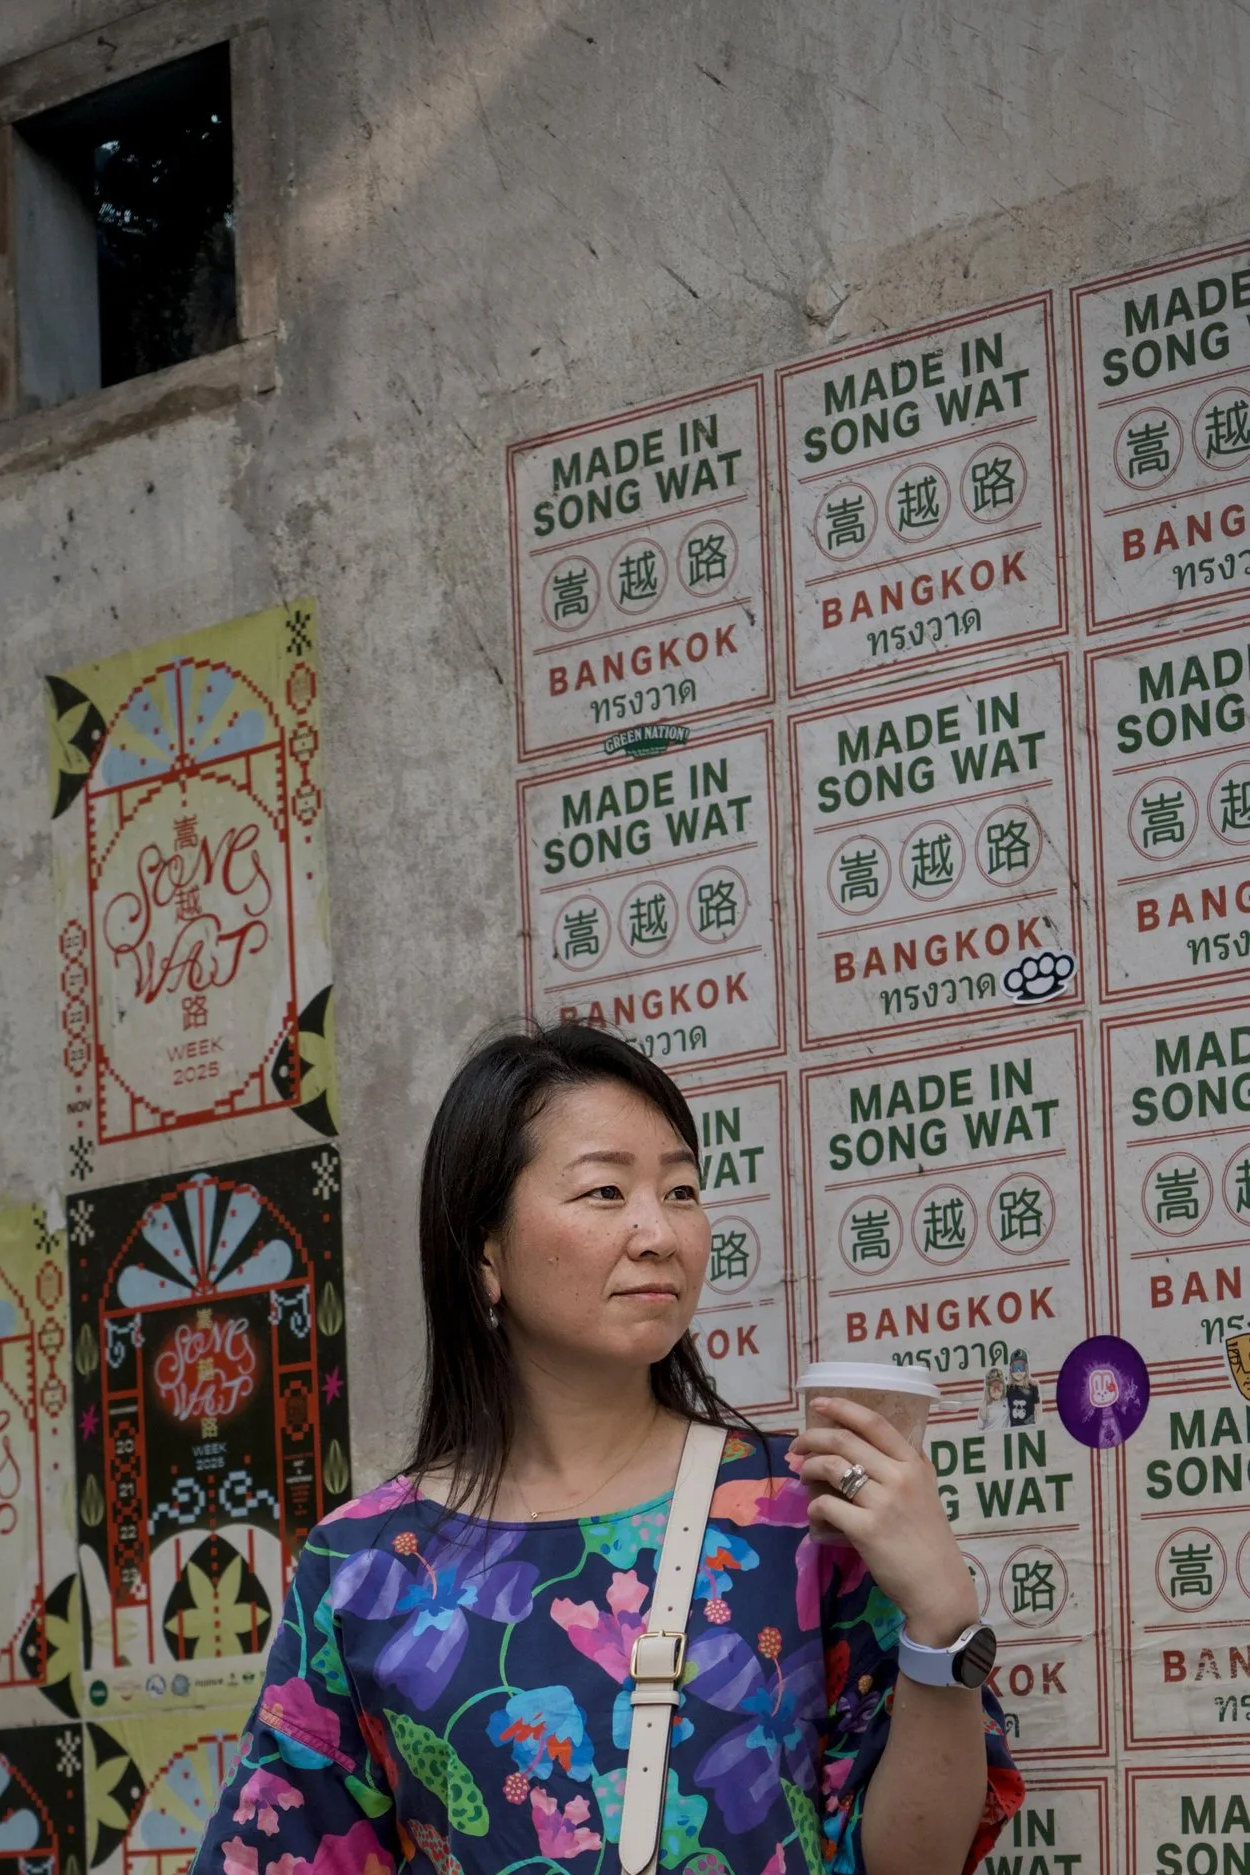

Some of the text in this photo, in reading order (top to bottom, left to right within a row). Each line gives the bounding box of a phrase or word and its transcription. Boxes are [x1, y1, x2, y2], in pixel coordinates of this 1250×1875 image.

[823, 332, 1004, 416] MADE IN
[1102, 321, 1230, 388] SONG
[803, 368, 1030, 463] SONG WAT
[552, 413, 718, 491] MADE IN
[533, 449, 742, 537] SONG WAT
[821, 551, 1027, 629] BANGKOK
[549, 624, 738, 697] BANGKOK
[867, 607, 982, 656] ทรงวาด
[590, 678, 697, 724] ทรงวาด
[1139, 644, 1250, 704] MAD
[605, 727, 642, 752] GREEN
[838, 691, 1020, 766] MADE IN
[1117, 692, 1246, 754] SONG
[561, 757, 728, 829] MADE IN
[817, 730, 1045, 814] SONG WAT
[543, 795, 752, 874] SONG WAT
[103, 824, 272, 954] SONG
[113, 913, 268, 1004] WAT
[834, 916, 1044, 984] BANGKOK
[880, 972, 996, 1016] ทรงวาด
[167, 1036, 225, 1063] WEEK
[173, 1061, 220, 1086] 2025
[66, 1099, 92, 1115] NOV
[849, 1057, 1034, 1125] MADE IN
[702, 1106, 741, 1148] IN
[829, 1098, 1060, 1171] SONG WAT
[847, 1287, 1055, 1343] BANGKOK
[154, 1318, 256, 1389] SONG
[160, 1368, 253, 1421] WAT
[115, 1439, 134, 1454] 20
[192, 1442, 227, 1456] WEEK
[931, 1430, 1047, 1478] DE IN
[1169, 1406, 1250, 1450] MA
[118, 1482, 135, 1497] 21
[976, 1473, 1073, 1519] WAT
[1146, 1453, 1250, 1500] SON
[119, 1525, 137, 1540] 22
[1013, 1808, 1056, 1848] IN
